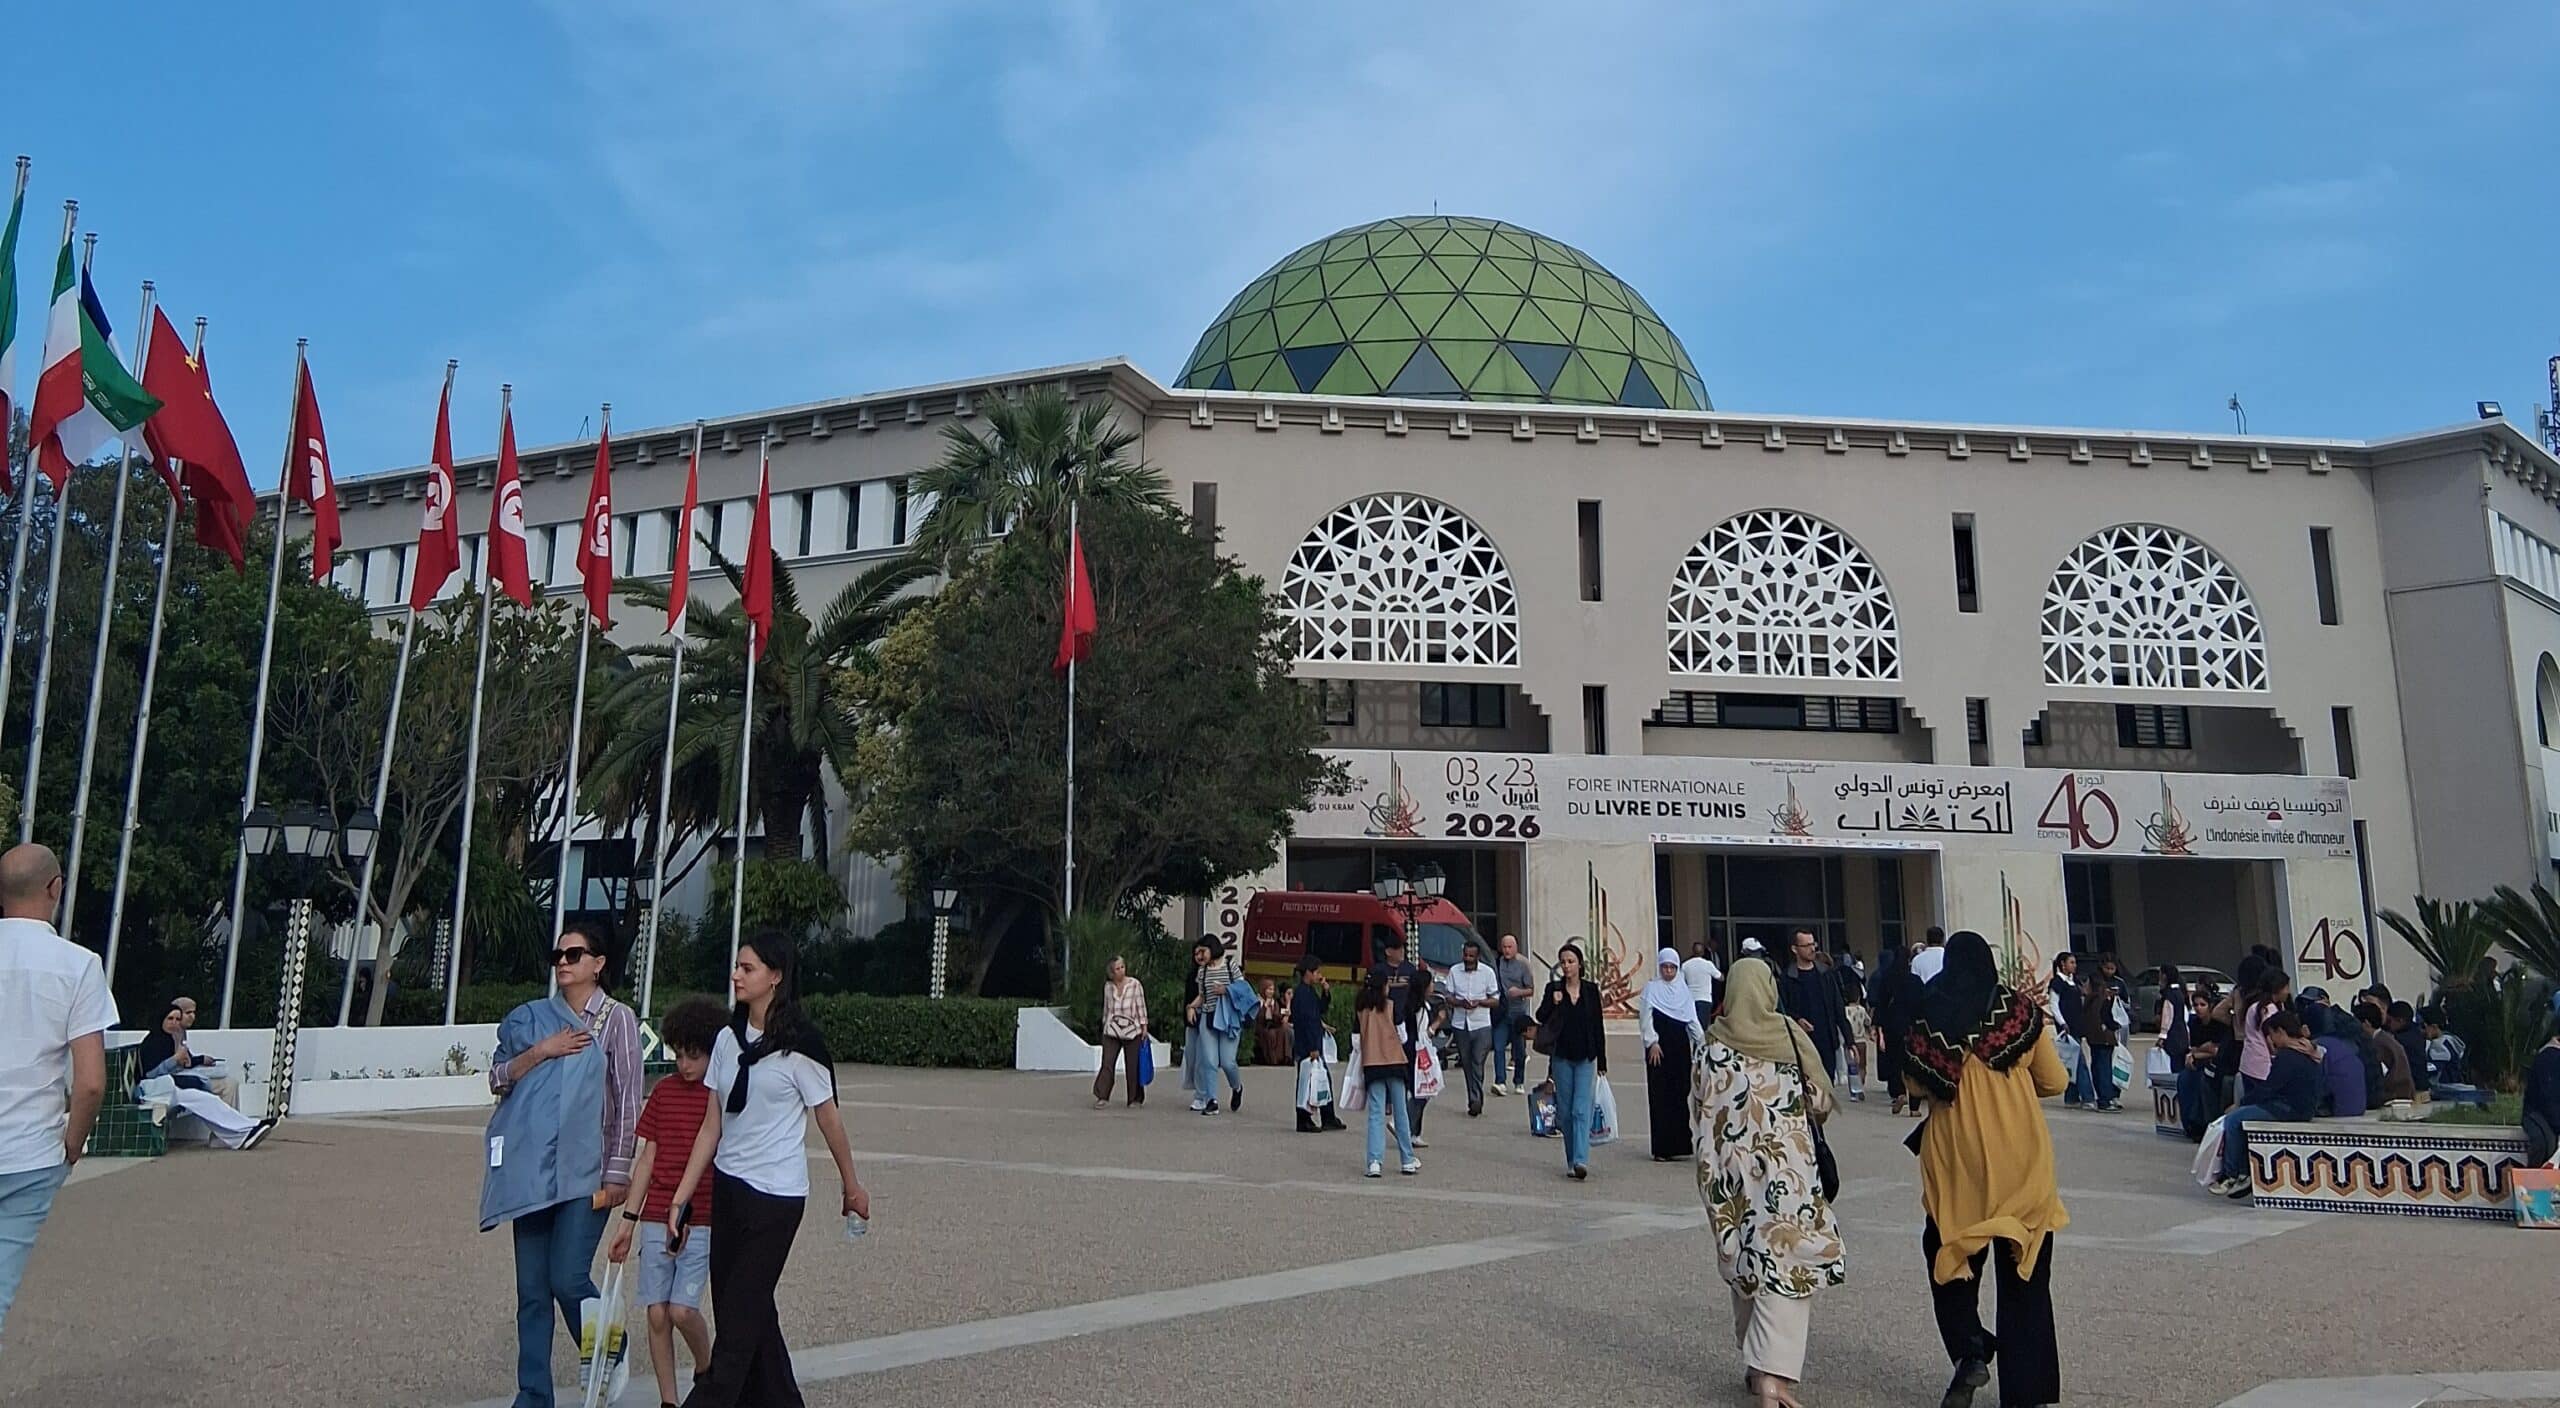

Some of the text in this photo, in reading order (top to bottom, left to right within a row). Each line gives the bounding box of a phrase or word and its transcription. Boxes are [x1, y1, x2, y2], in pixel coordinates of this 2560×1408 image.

[1446, 757, 1480, 787] 03
[1503, 757, 1535, 787] 23
[1446, 786, 1480, 805] ماي
[1568, 778, 1745, 796] FOIRE INTERNATIONALE
[1834, 774, 2005, 800] معرض تونس الدولي
[1319, 803, 1330, 811] DU
[1332, 803, 1355, 811] KRAM
[1568, 800, 1746, 819] DU LIVRE DE TUNIS
[2037, 773, 2119, 850] 40
[2203, 794, 2241, 814] شرف
[1445, 813, 1541, 839] 2026
[2261, 829, 2294, 844] invitée
[2298, 917, 2366, 981] 40
